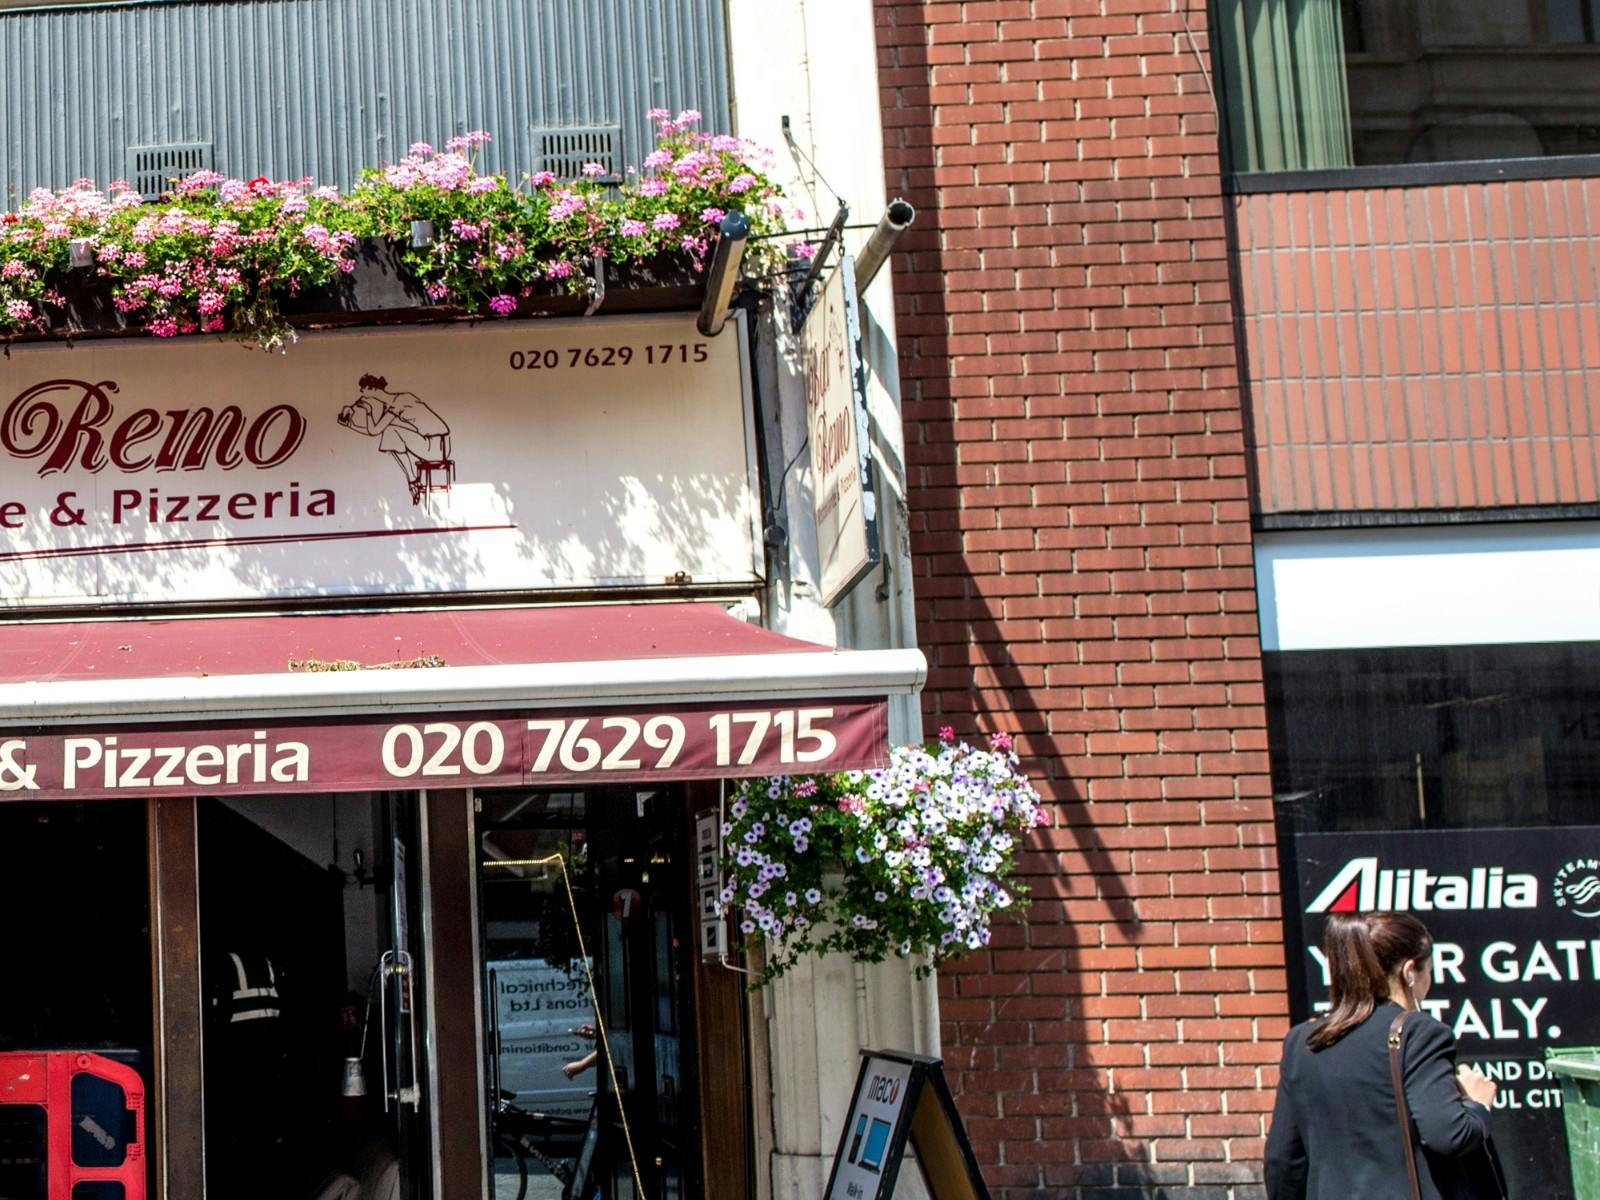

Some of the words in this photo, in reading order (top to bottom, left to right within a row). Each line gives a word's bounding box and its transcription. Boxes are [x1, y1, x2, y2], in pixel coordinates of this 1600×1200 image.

[509, 349, 559, 370] 020
[567, 346, 633, 367] 7629
[645, 343, 708, 364] 1715
[807, 340, 831, 409] Bar
[0, 379, 307, 479] Remo
[816, 405, 850, 480] Remo
[49, 491, 87, 527] &
[112, 482, 336, 525] Pizzeria
[63, 730, 310, 789] Pizzeria
[381, 720, 505, 778] 020
[528, 715, 686, 773] 7629
[709, 707, 837, 767] 1715
[1305, 857, 1538, 913] Alitalia
[1308, 943, 1466, 986] YR
[1419, 998, 1561, 1040] TALY.
[1526, 1089, 1561, 1108] CIT
